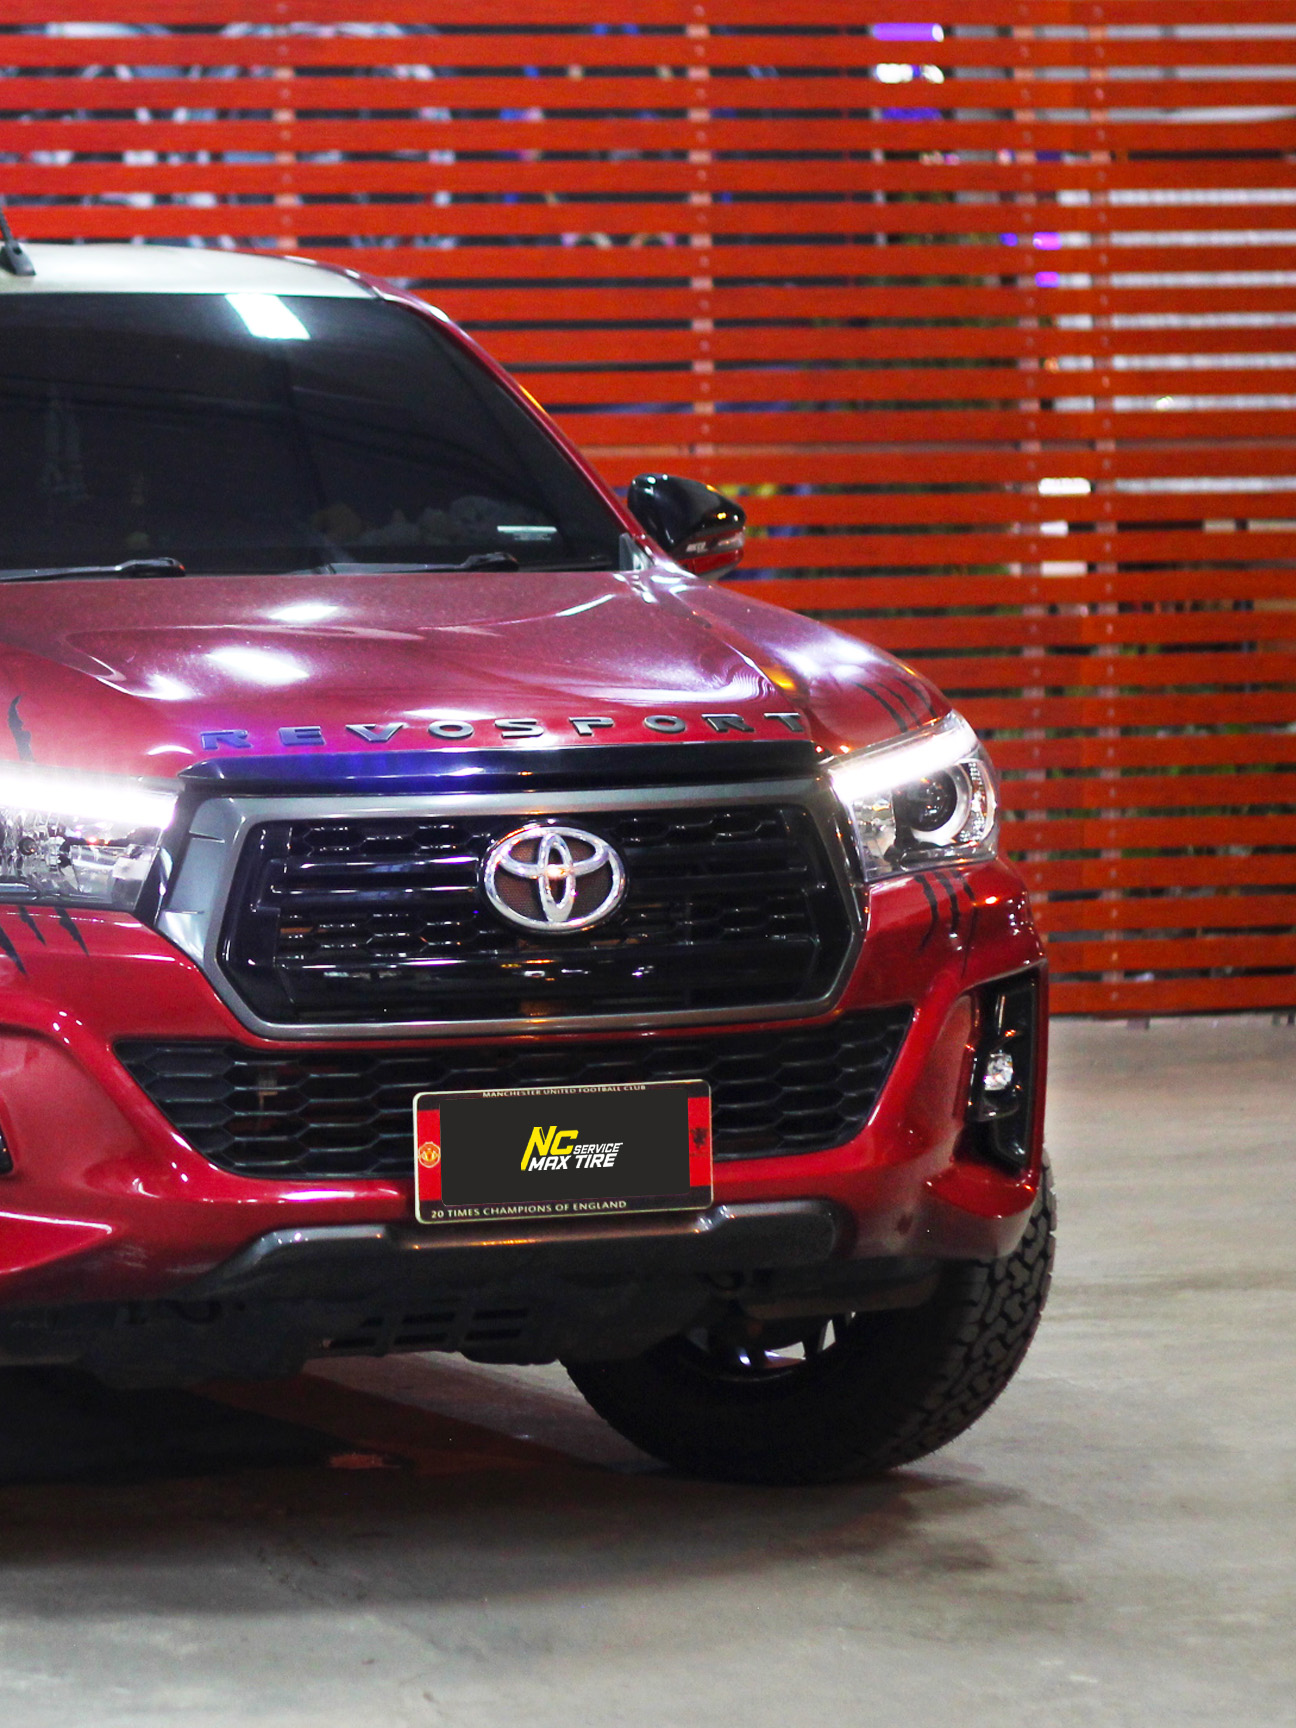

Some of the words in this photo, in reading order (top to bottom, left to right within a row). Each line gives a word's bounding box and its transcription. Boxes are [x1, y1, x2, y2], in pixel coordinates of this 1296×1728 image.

[200, 712, 804, 749] REVOSPORT
[482, 1089, 541, 1098] MANCHESTER
[543, 1087, 576, 1095] UNITED
[578, 1085, 621, 1093] FOOTBALL
[431, 1209, 445, 1219] 20
[447, 1207, 480, 1218] TIMES
[482, 1203, 552, 1216] CHAMPIONS
[554, 1202, 570, 1212] OF
[572, 1200, 628, 1211] ENGLAND
